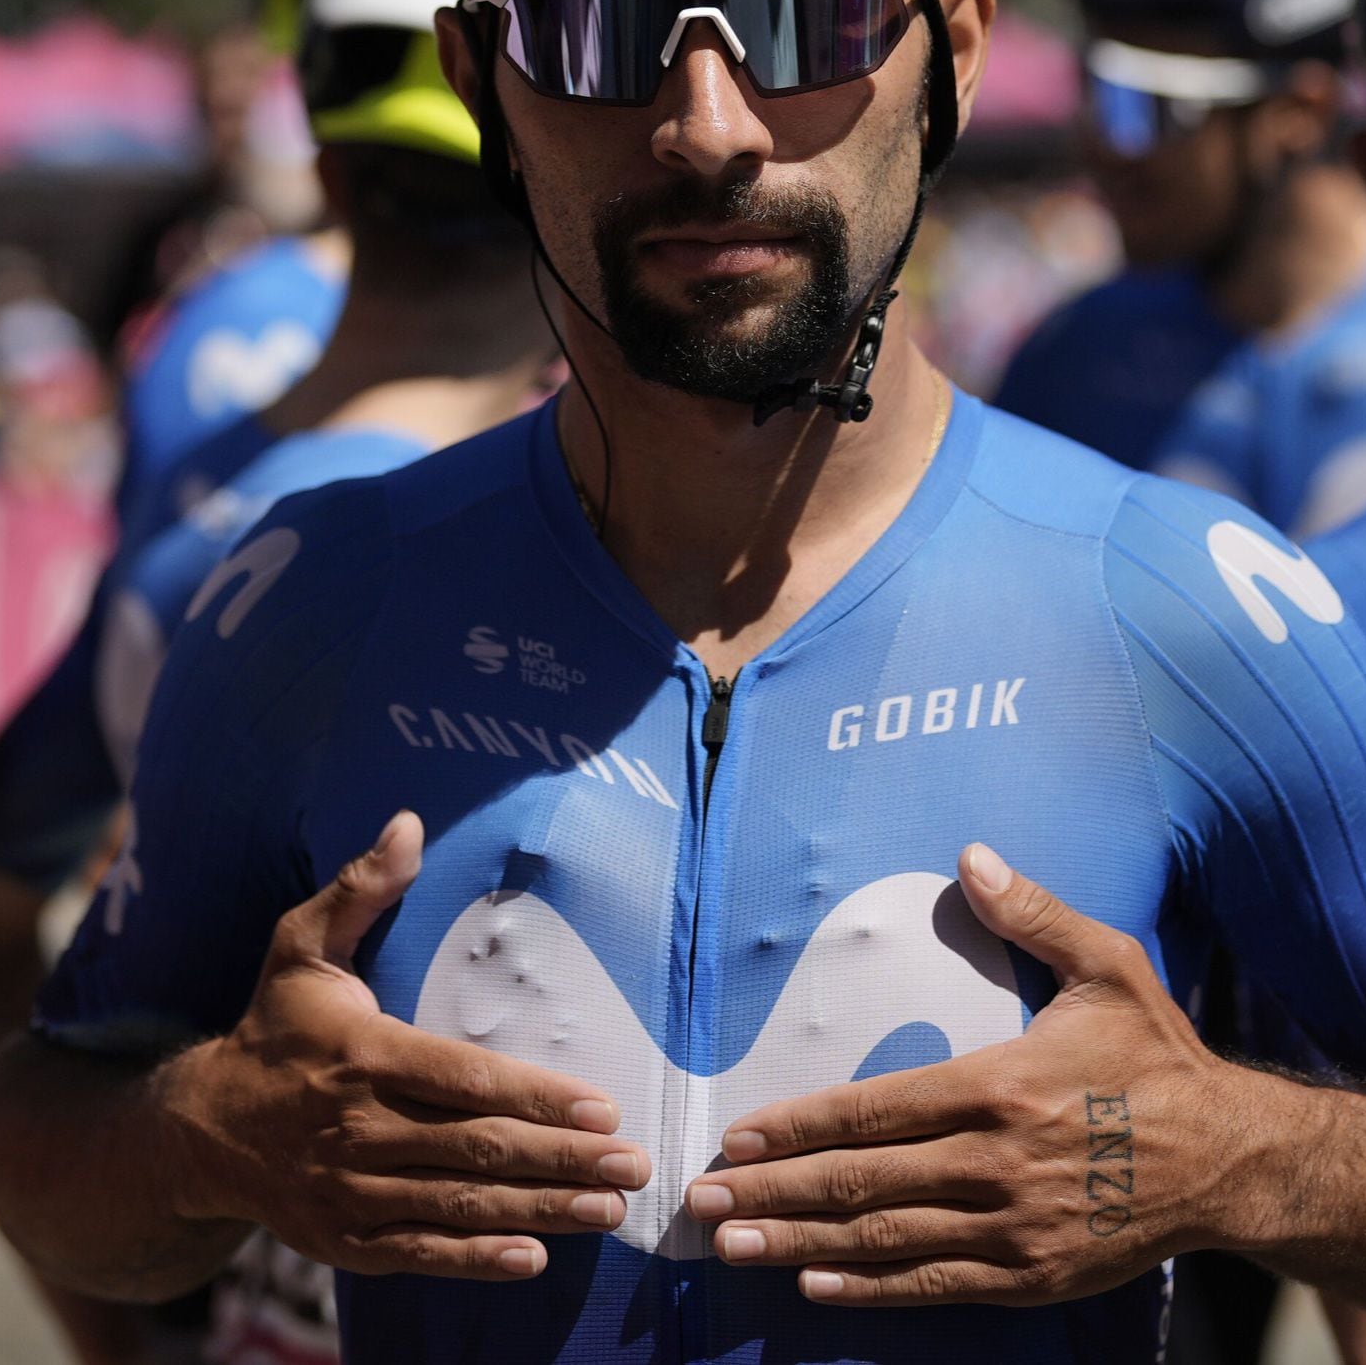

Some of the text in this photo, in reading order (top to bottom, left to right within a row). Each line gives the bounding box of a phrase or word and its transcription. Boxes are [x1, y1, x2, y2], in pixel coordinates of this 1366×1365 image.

[516, 635, 556, 660] UCI
[518, 653, 587, 685] WORLD
[519, 668, 569, 695] TEAM
[826, 676, 1027, 752] GOBIK
[387, 703, 680, 811] CANYON
[1085, 1090, 1135, 1239] ENZO
